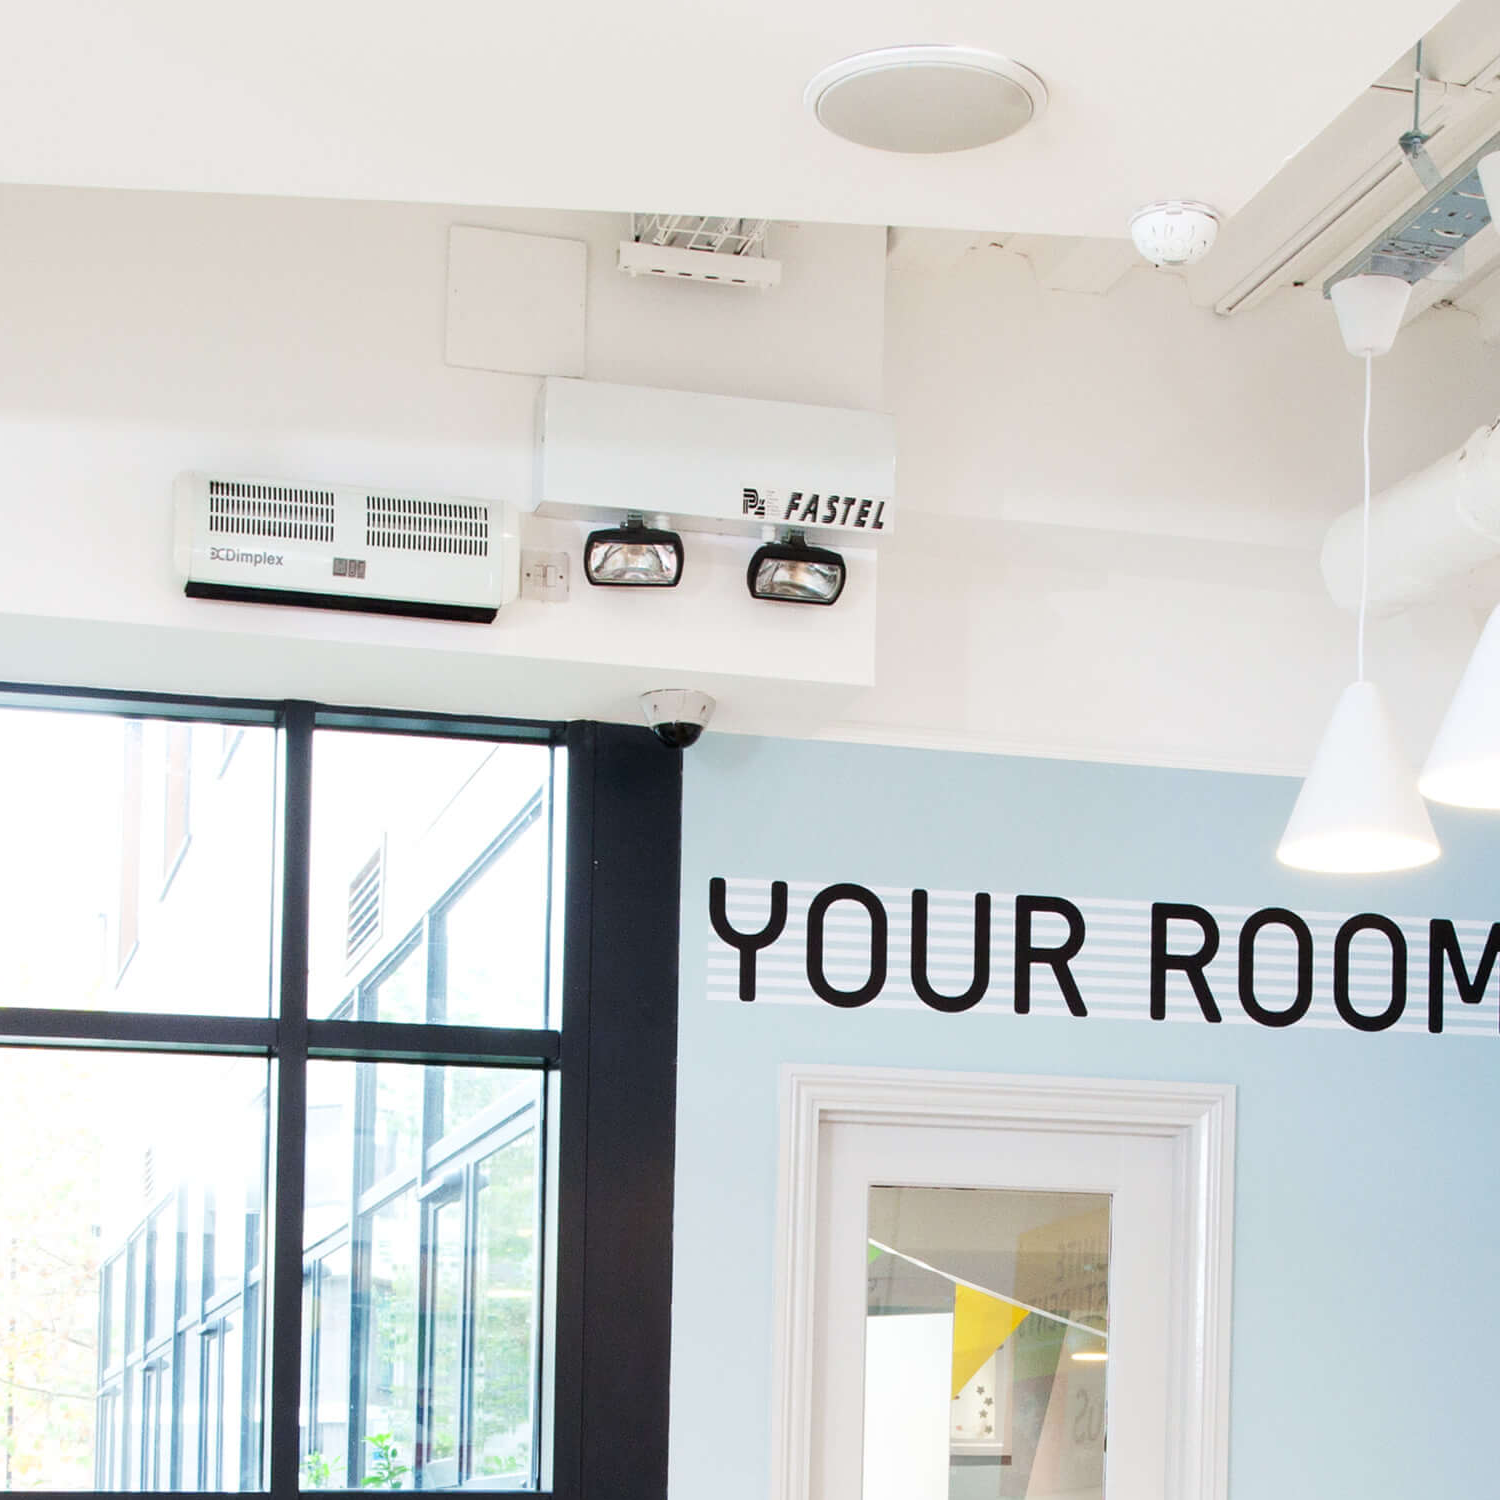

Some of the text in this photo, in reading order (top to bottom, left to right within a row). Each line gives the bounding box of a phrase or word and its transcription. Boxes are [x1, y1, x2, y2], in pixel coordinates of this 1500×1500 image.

[784, 492, 885, 529] FASTEL
[226, 548, 284, 566] Dimplex
[708, 877, 1088, 1018] YOUR
